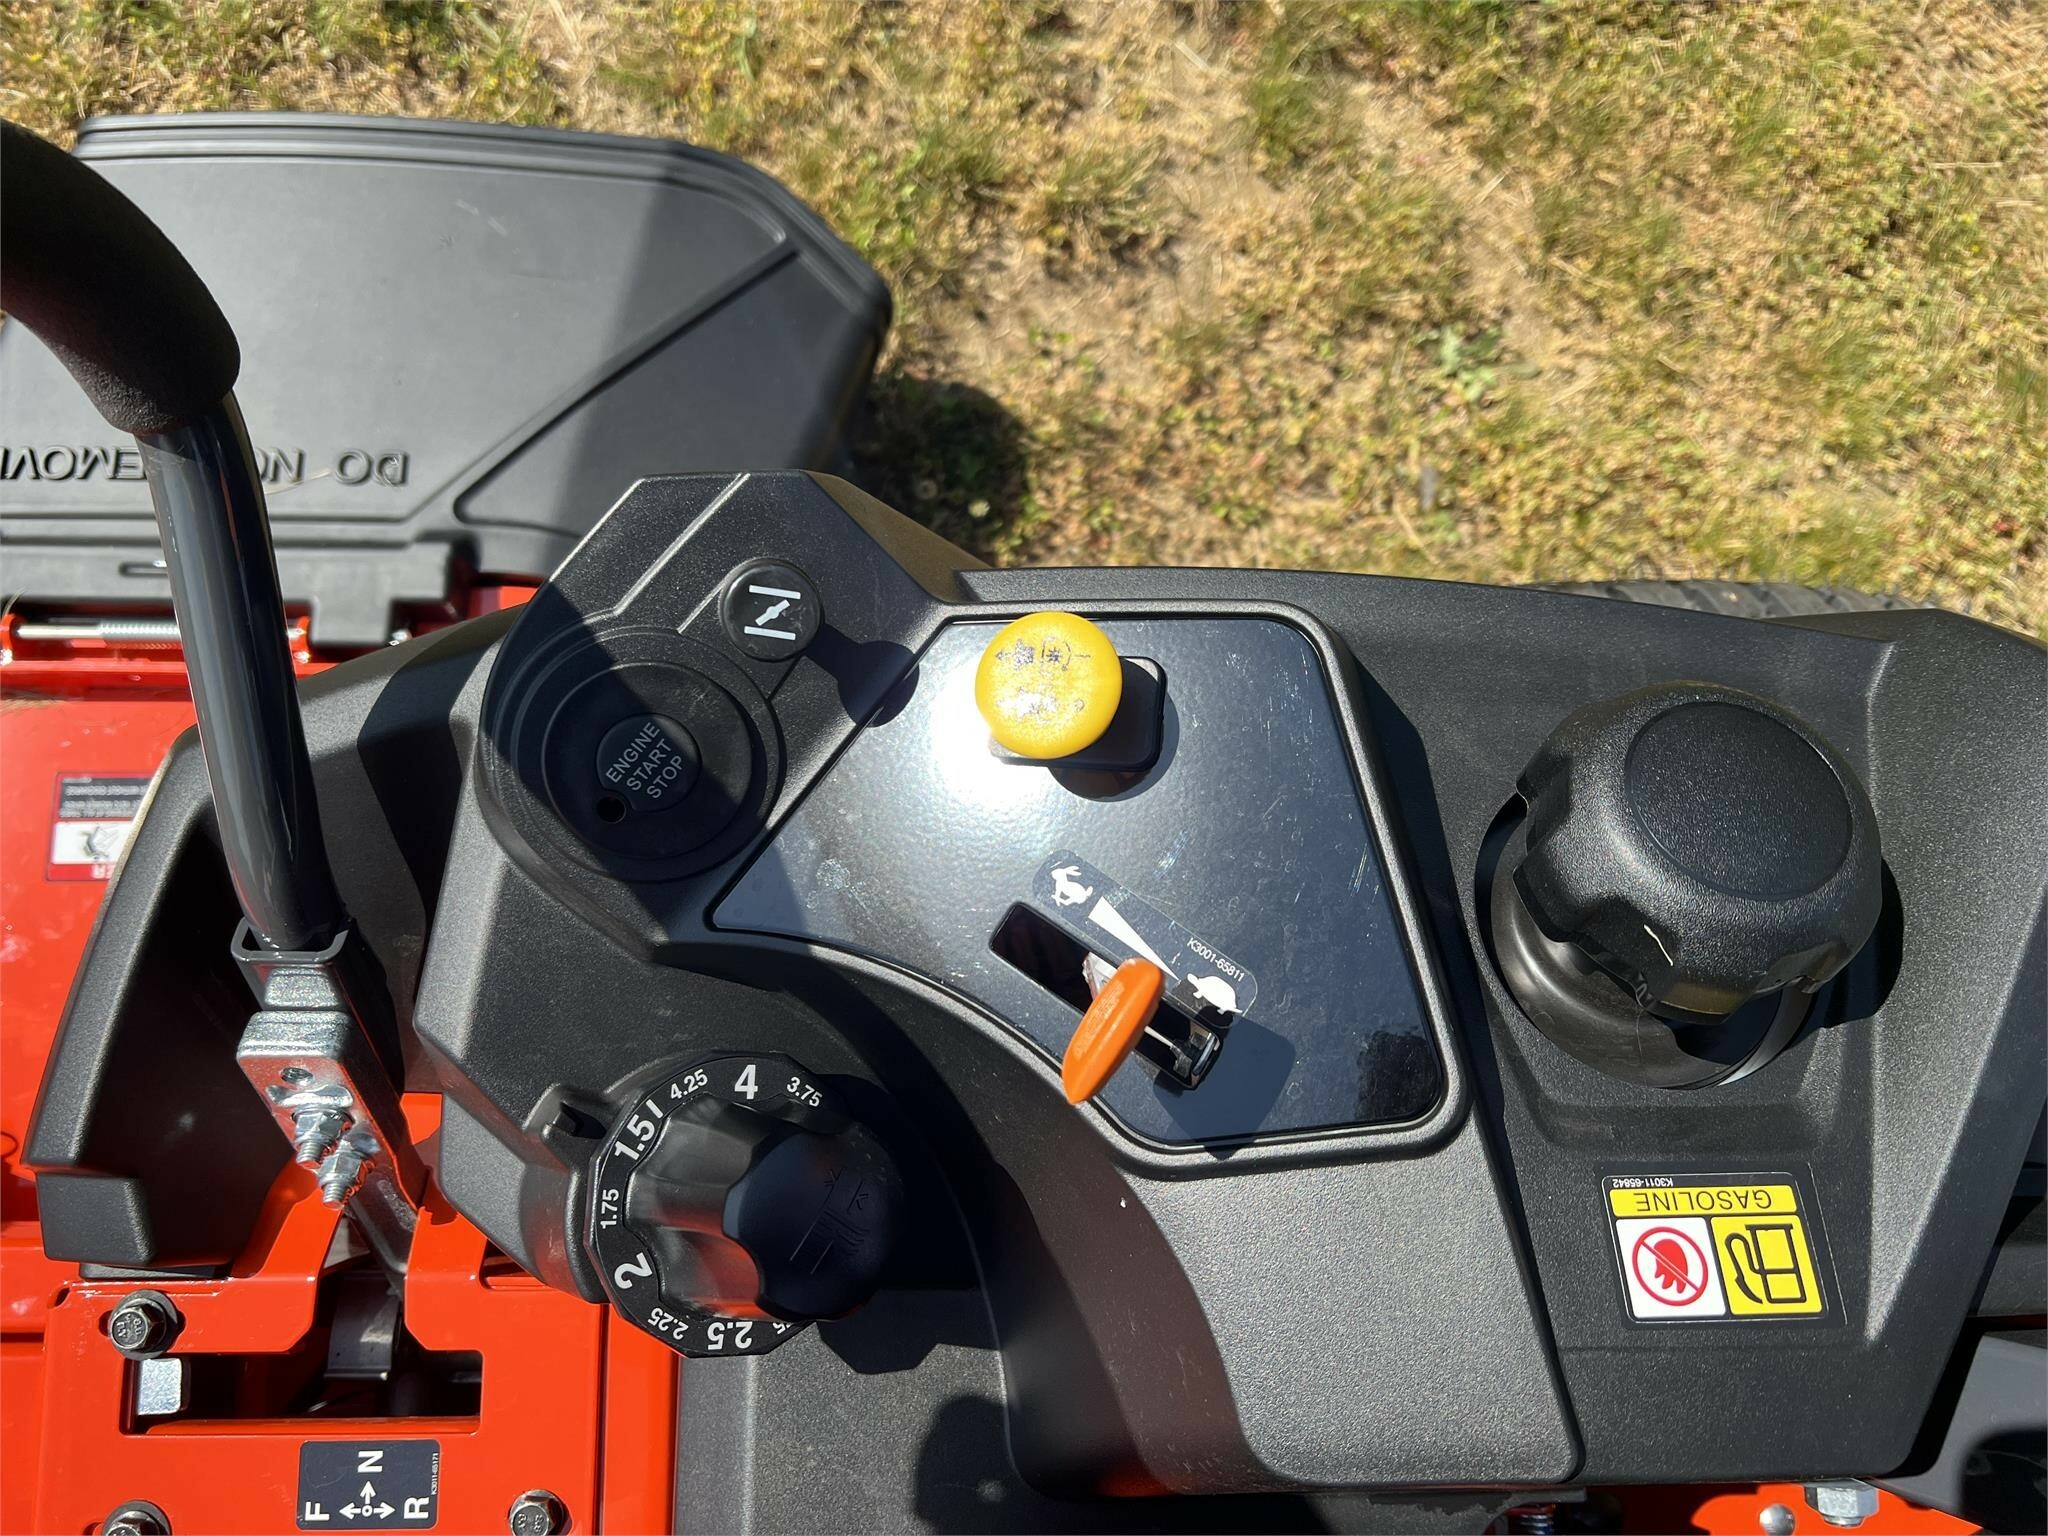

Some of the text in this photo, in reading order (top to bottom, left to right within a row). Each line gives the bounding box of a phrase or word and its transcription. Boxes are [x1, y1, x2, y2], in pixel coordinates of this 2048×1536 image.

[0, 446, 148, 481] EMOV
[335, 449, 410, 487] DO
[605, 722, 661, 784] ENGINE
[626, 738, 672, 791] START
[646, 755, 682, 799] STOP
[1186, 936, 1246, 983] K3001-65811
[669, 1068, 709, 1101] 4.25
[734, 1064, 759, 1100] 4
[786, 1076, 824, 1108] 3.75
[614, 1113, 656, 1161] 1.5
[1612, 1177, 1674, 1189] K3011-65842
[1633, 1188, 1773, 1213] GASOLINE
[600, 1188, 620, 1230] 1.75
[614, 1252, 654, 1290] 2
[647, 1306, 690, 1341] 2.25
[707, 1320, 754, 1351] 2.5
[357, 1450, 384, 1473] N
[304, 1501, 331, 1522] F
[403, 1496, 431, 1520] R
